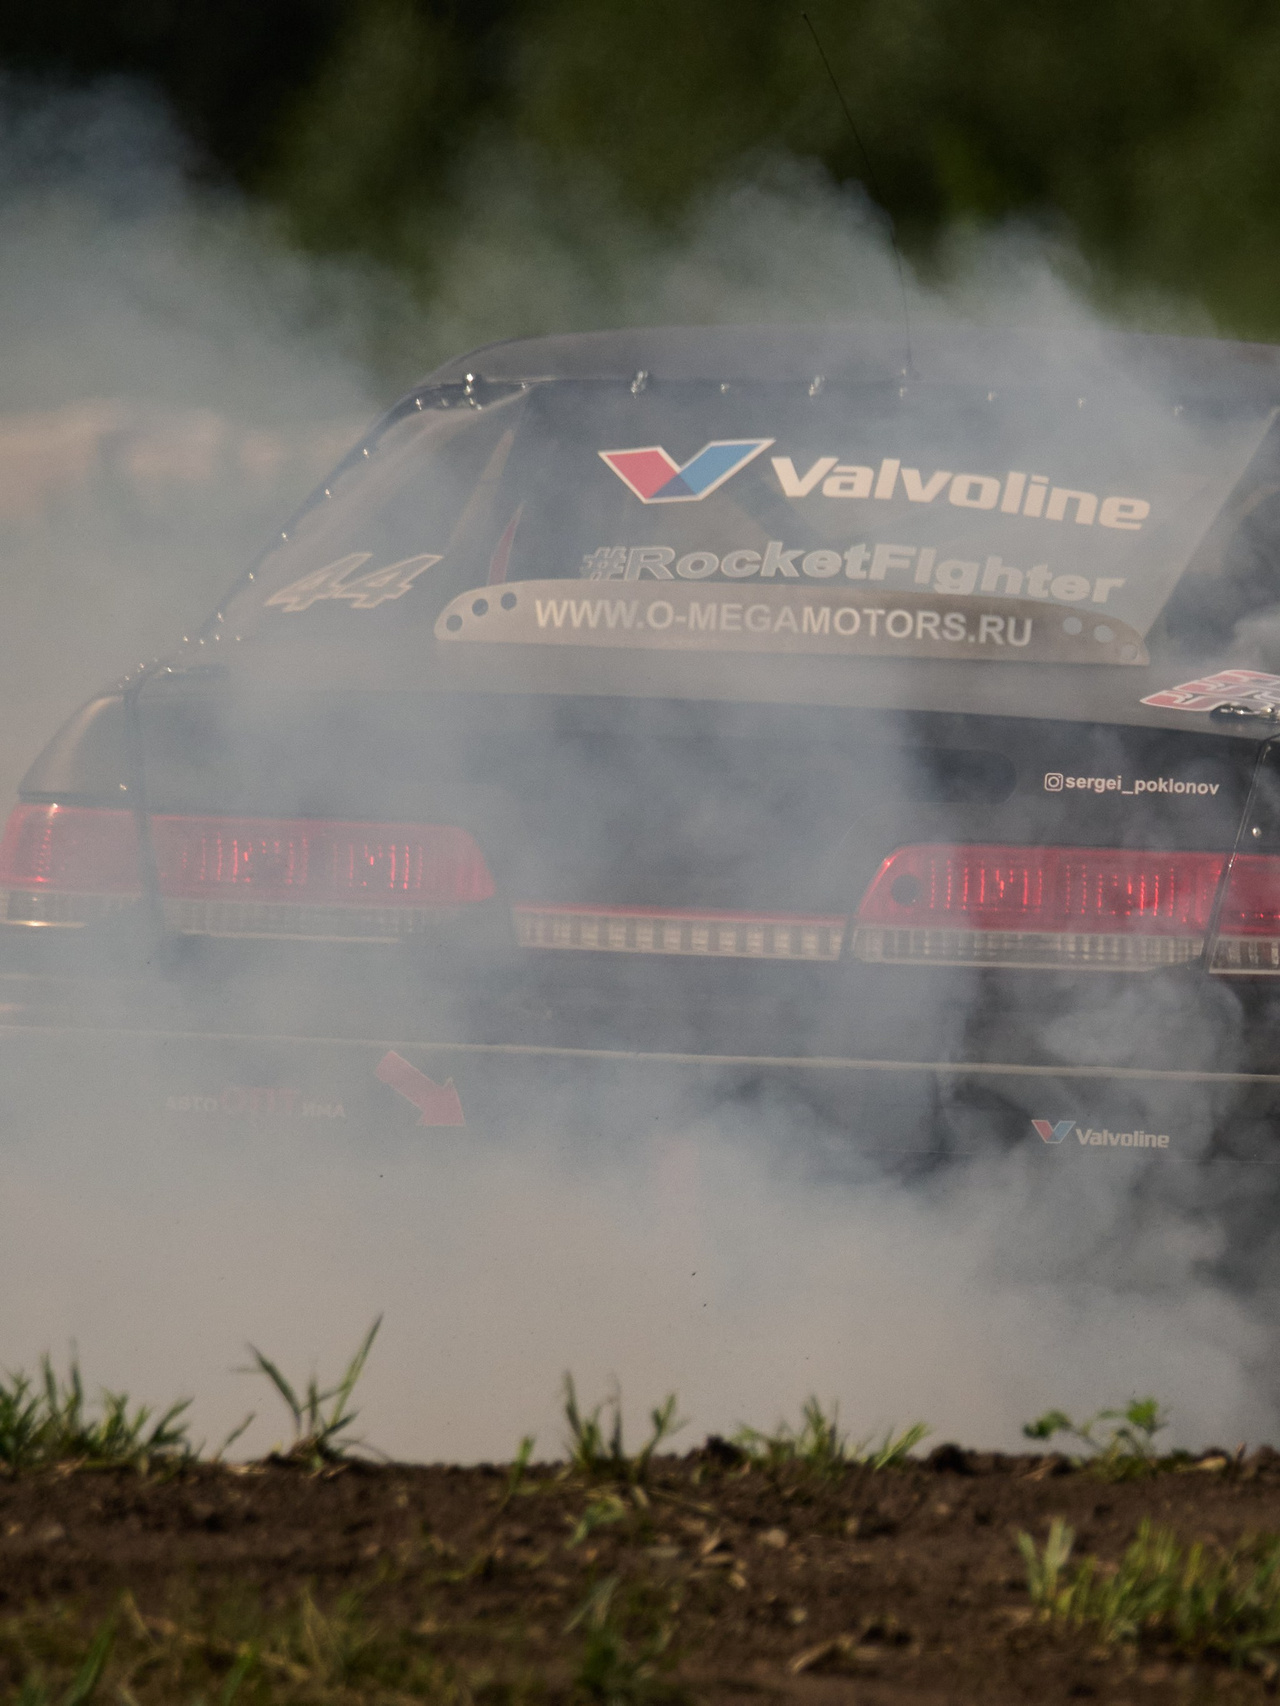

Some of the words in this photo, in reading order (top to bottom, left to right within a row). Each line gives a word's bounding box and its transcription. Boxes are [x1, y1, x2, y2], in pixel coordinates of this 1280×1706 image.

[771, 456, 1151, 531] Valvoline
[264, 553, 444, 613] 44
[534, 599, 1033, 648] WWW.O-MEGAMOTORS.RU
[1064, 774, 1220, 796] sergei_poklonov
[1075, 1127, 1171, 1149] Valvoline
